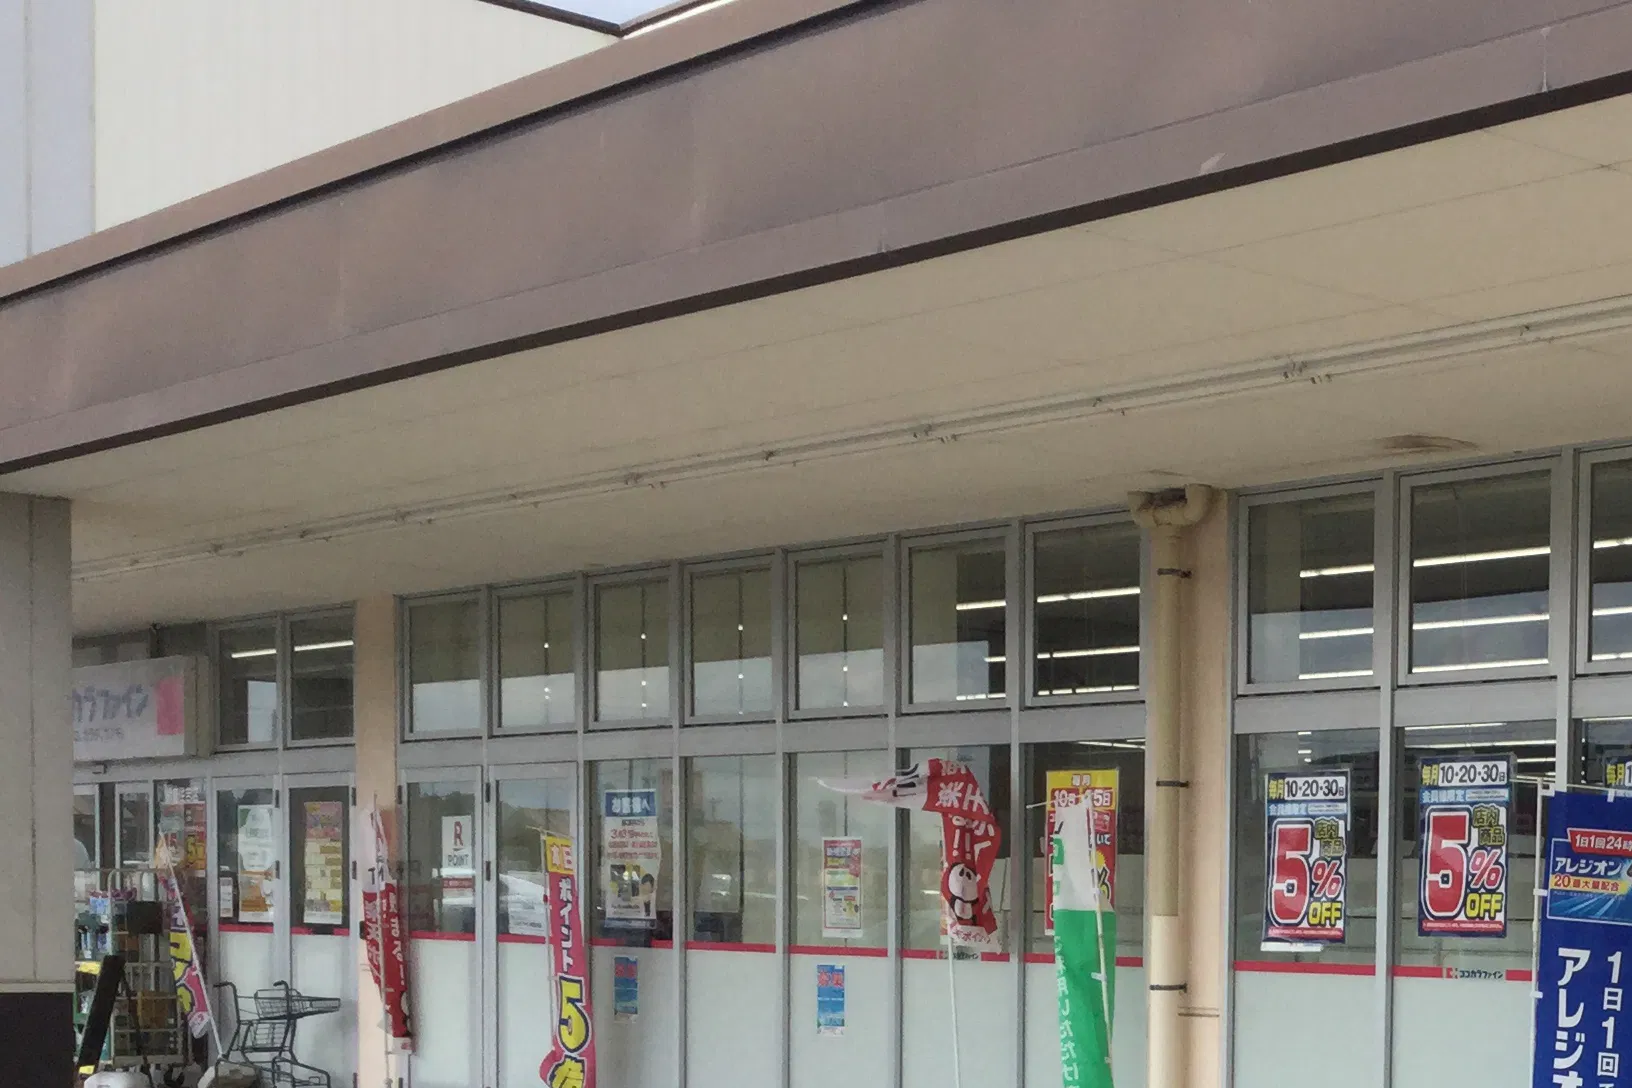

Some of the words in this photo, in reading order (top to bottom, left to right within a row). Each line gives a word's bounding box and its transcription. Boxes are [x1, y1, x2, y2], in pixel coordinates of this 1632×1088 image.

[1422, 764, 1439, 785] 毎月
[1607, 764, 1625, 784] 毎月
[1269, 779, 1284, 799] 毎月
[453, 821, 465, 846] R
[448, 854, 469, 866] POINT
[1426, 812, 1471, 917] 5
[1465, 893, 1503, 919] OFF
[1555, 857, 1623, 877] アレジオン
[1272, 824, 1311, 924] 5
[1308, 901, 1342, 926] OFF
[1554, 874, 1571, 888] 20
[559, 877, 574, 972] ポイント
[1459, 969, 1503, 979] ココカラファイン
